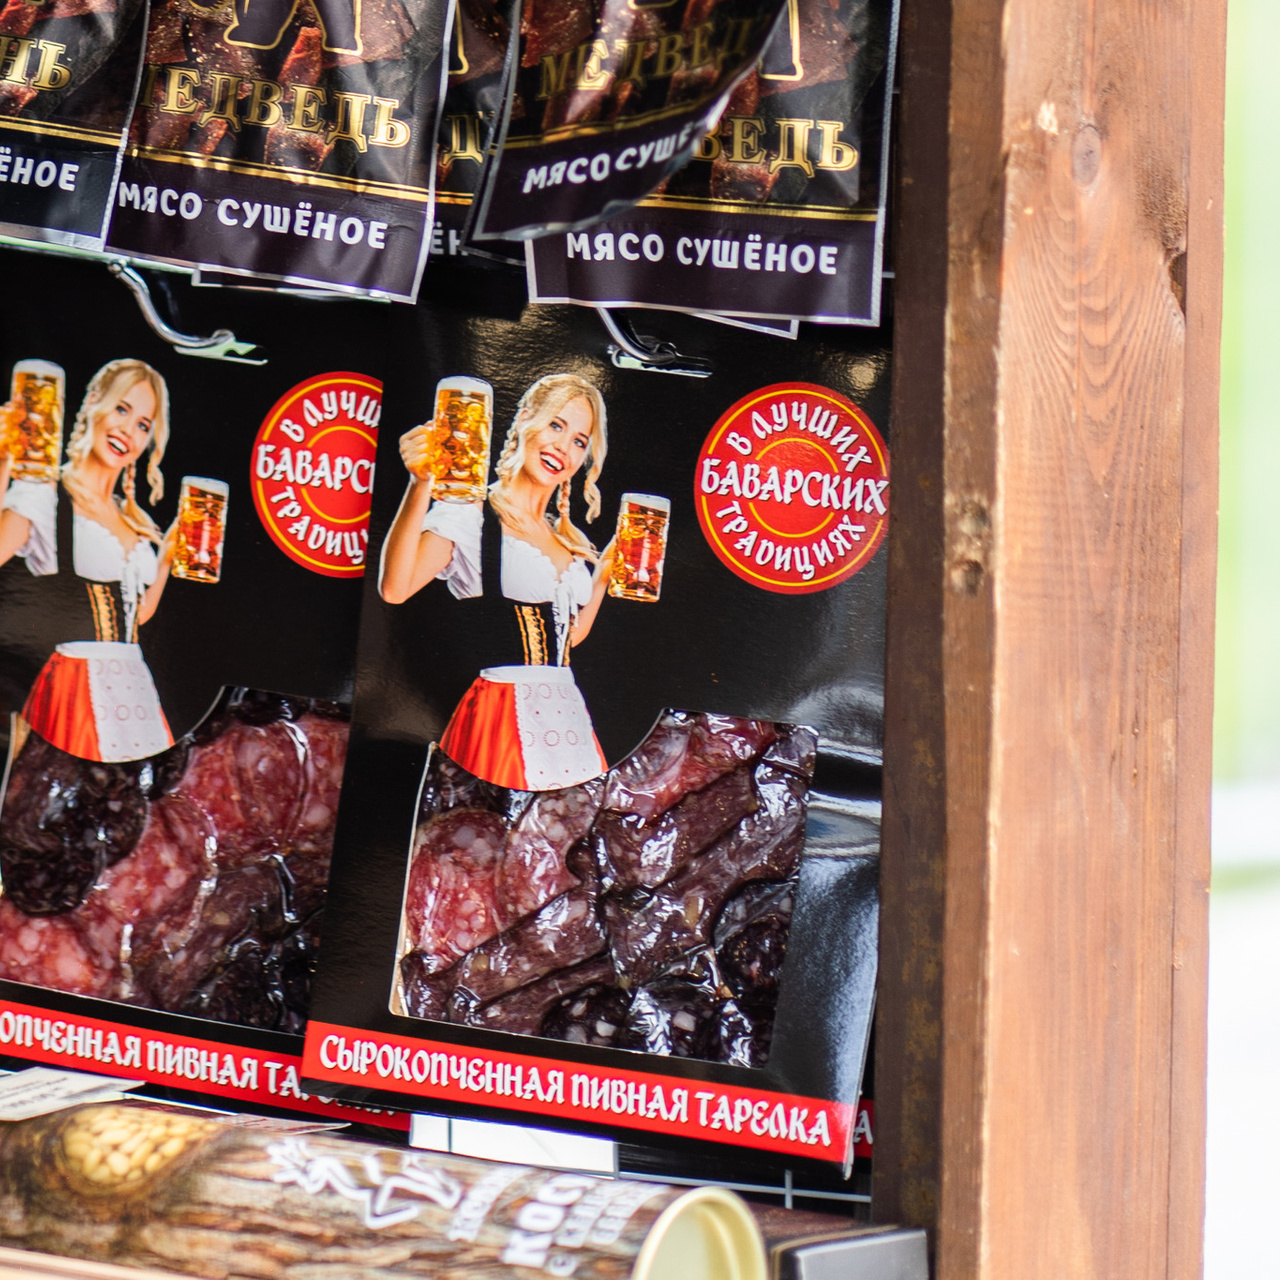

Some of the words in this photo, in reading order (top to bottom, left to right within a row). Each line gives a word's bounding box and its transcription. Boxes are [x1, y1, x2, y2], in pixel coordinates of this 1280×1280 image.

[522, 153, 610, 194] МЯСО
[694, 115, 859, 178] ВЕДЬ
[118, 180, 204, 221] МЯСО
[216, 198, 389, 250] СУШЁНОЕ
[567, 232, 665, 263] МЯСО
[676, 235, 838, 275] СУШЁНОЕ
[279, 418, 305, 443] В
[302, 389, 382, 428] ЛУЧШ
[726, 431, 753, 456] В
[751, 401, 873, 473] ЛУЧШИХ
[255, 443, 377, 495] БАВАРС
[700, 457, 890, 516] БАВАРСКИХ
[270, 485, 370, 566] ТРАДИЦ
[716, 500, 867, 581] ТРАДИЦИЯХ
[146, 1039, 259, 1091] ПИВНАЯ
[319, 1032, 566, 1106] СЫРОКОПЧЕННАЯ
[571, 1071, 689, 1125] ПИВНАЯ
[694, 1090, 833, 1148] ТАРЕЛКА
